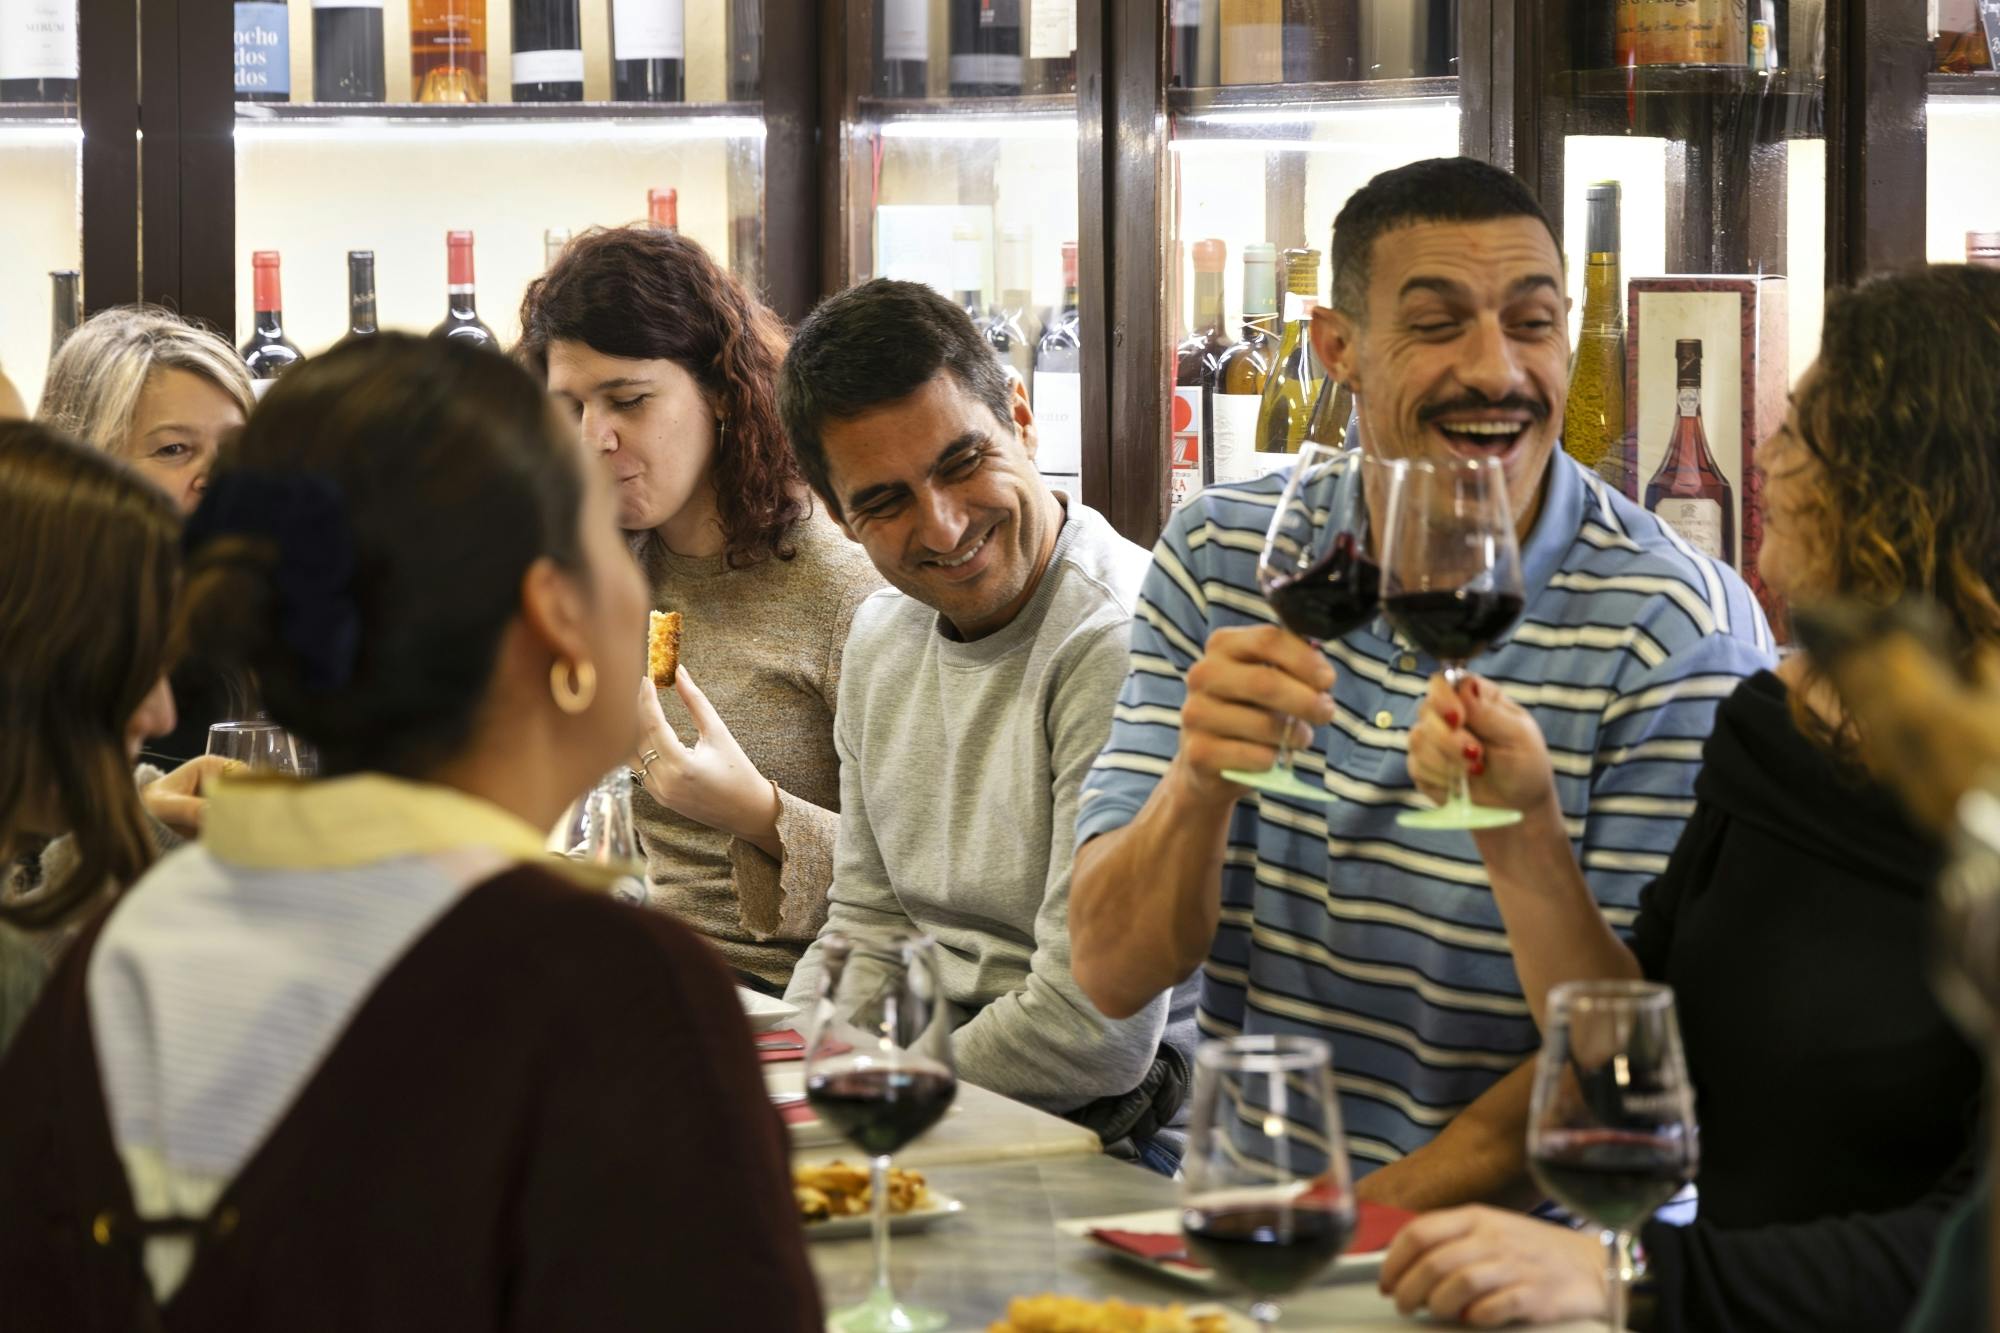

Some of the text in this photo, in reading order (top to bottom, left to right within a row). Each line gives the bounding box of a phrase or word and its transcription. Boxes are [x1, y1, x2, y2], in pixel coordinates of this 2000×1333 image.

[234, 26, 278, 46] ocho
[235, 47, 267, 65] dos
[235, 67, 267, 86] dos
